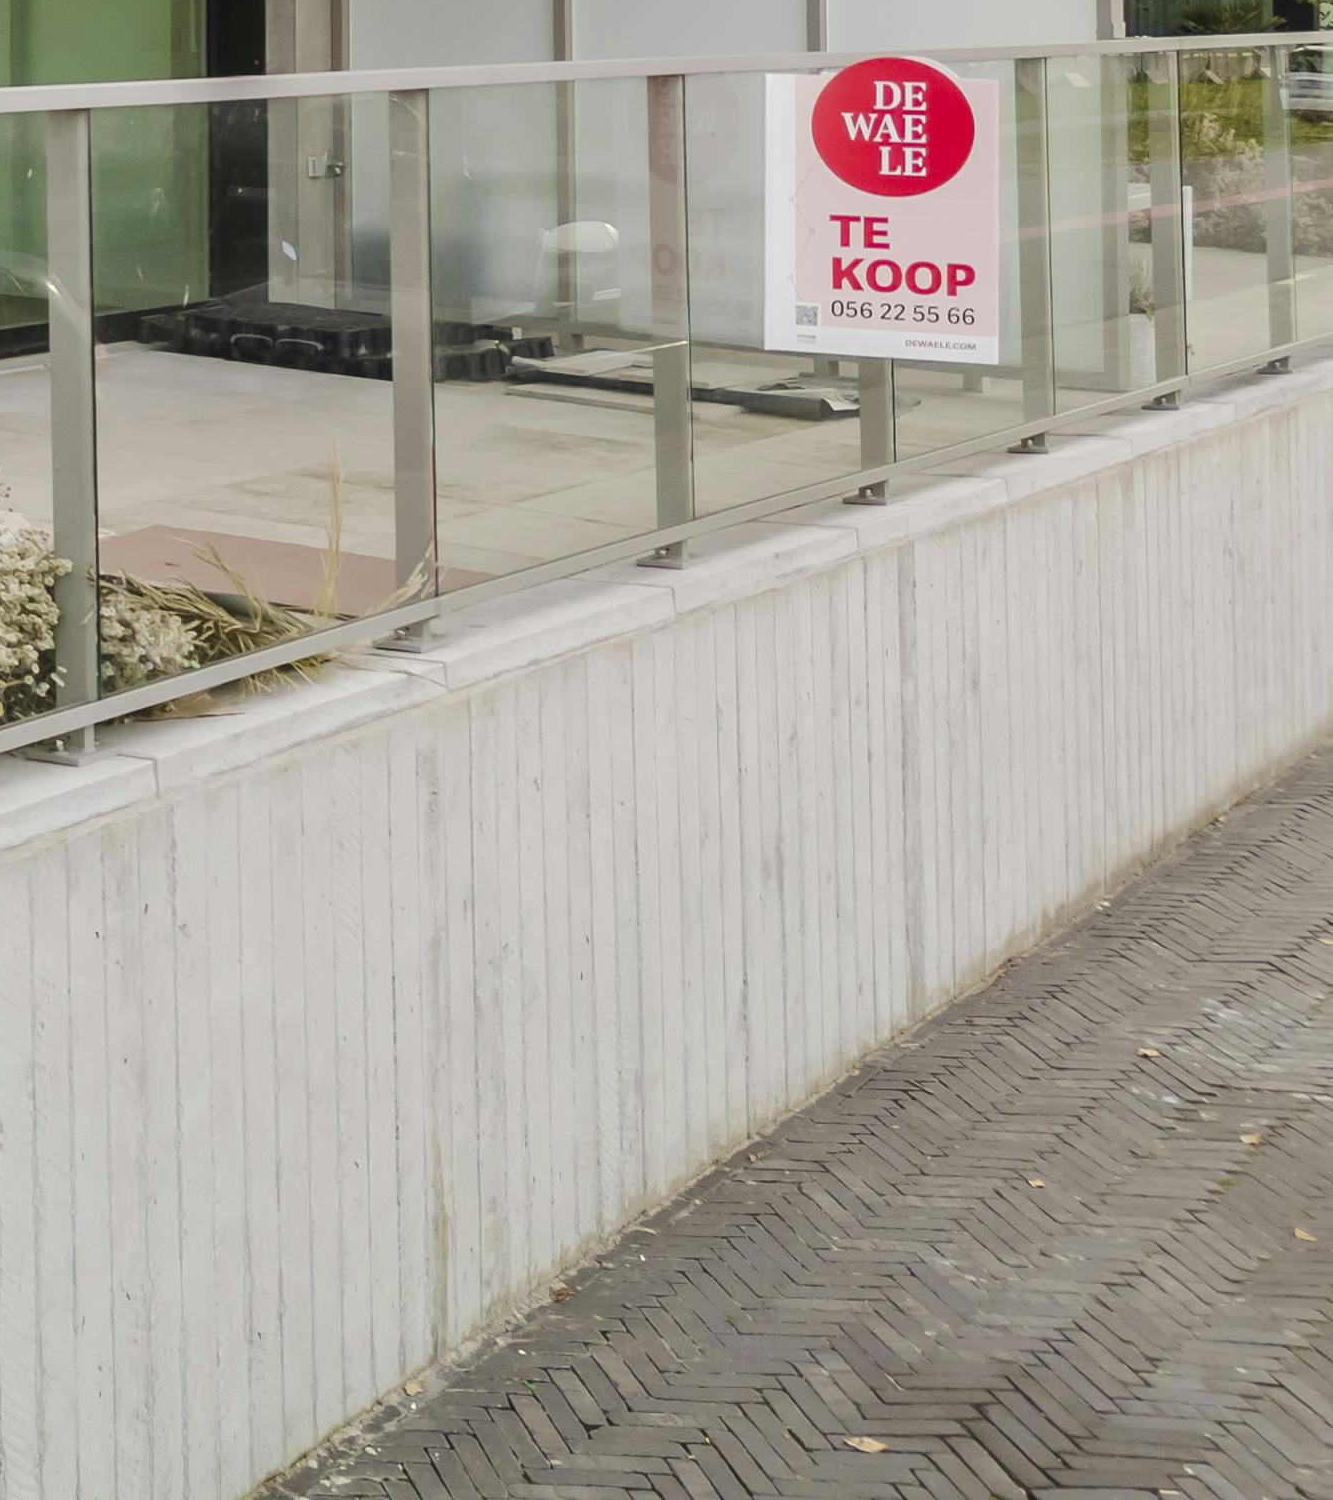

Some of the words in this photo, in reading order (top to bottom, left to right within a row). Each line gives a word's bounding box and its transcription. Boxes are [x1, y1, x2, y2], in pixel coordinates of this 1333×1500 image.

[873, 80, 927, 112] DE
[841, 112, 927, 144] WAE
[878, 145, 927, 177] LE
[829, 214, 891, 250] TE
[831, 256, 976, 297] KOOP
[830, 299, 874, 320] 056
[880, 302, 906, 322] 22
[912, 304, 940, 324] 55
[946, 306, 976, 326] 66
[904, 338, 977, 352] DEWAELE.COM
